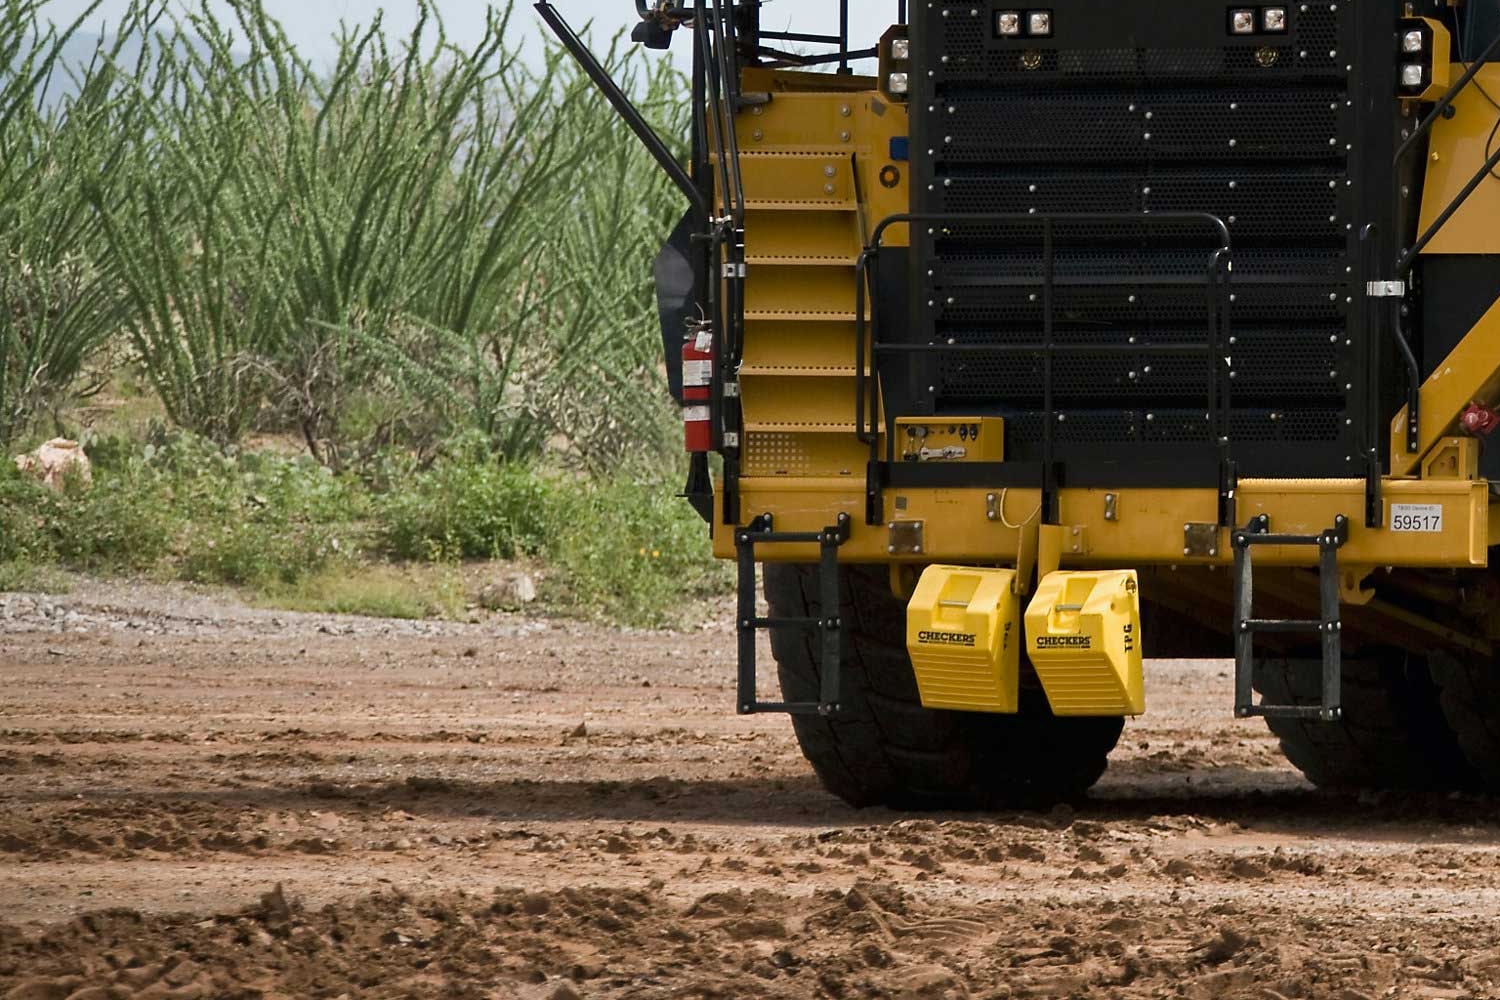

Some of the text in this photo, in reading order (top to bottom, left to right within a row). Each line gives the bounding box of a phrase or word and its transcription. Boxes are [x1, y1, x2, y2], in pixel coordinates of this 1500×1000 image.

[1393, 515, 1440, 530] 59517
[918, 631, 976, 643] CHECKERS
[1036, 636, 1092, 645] CHECKERS
